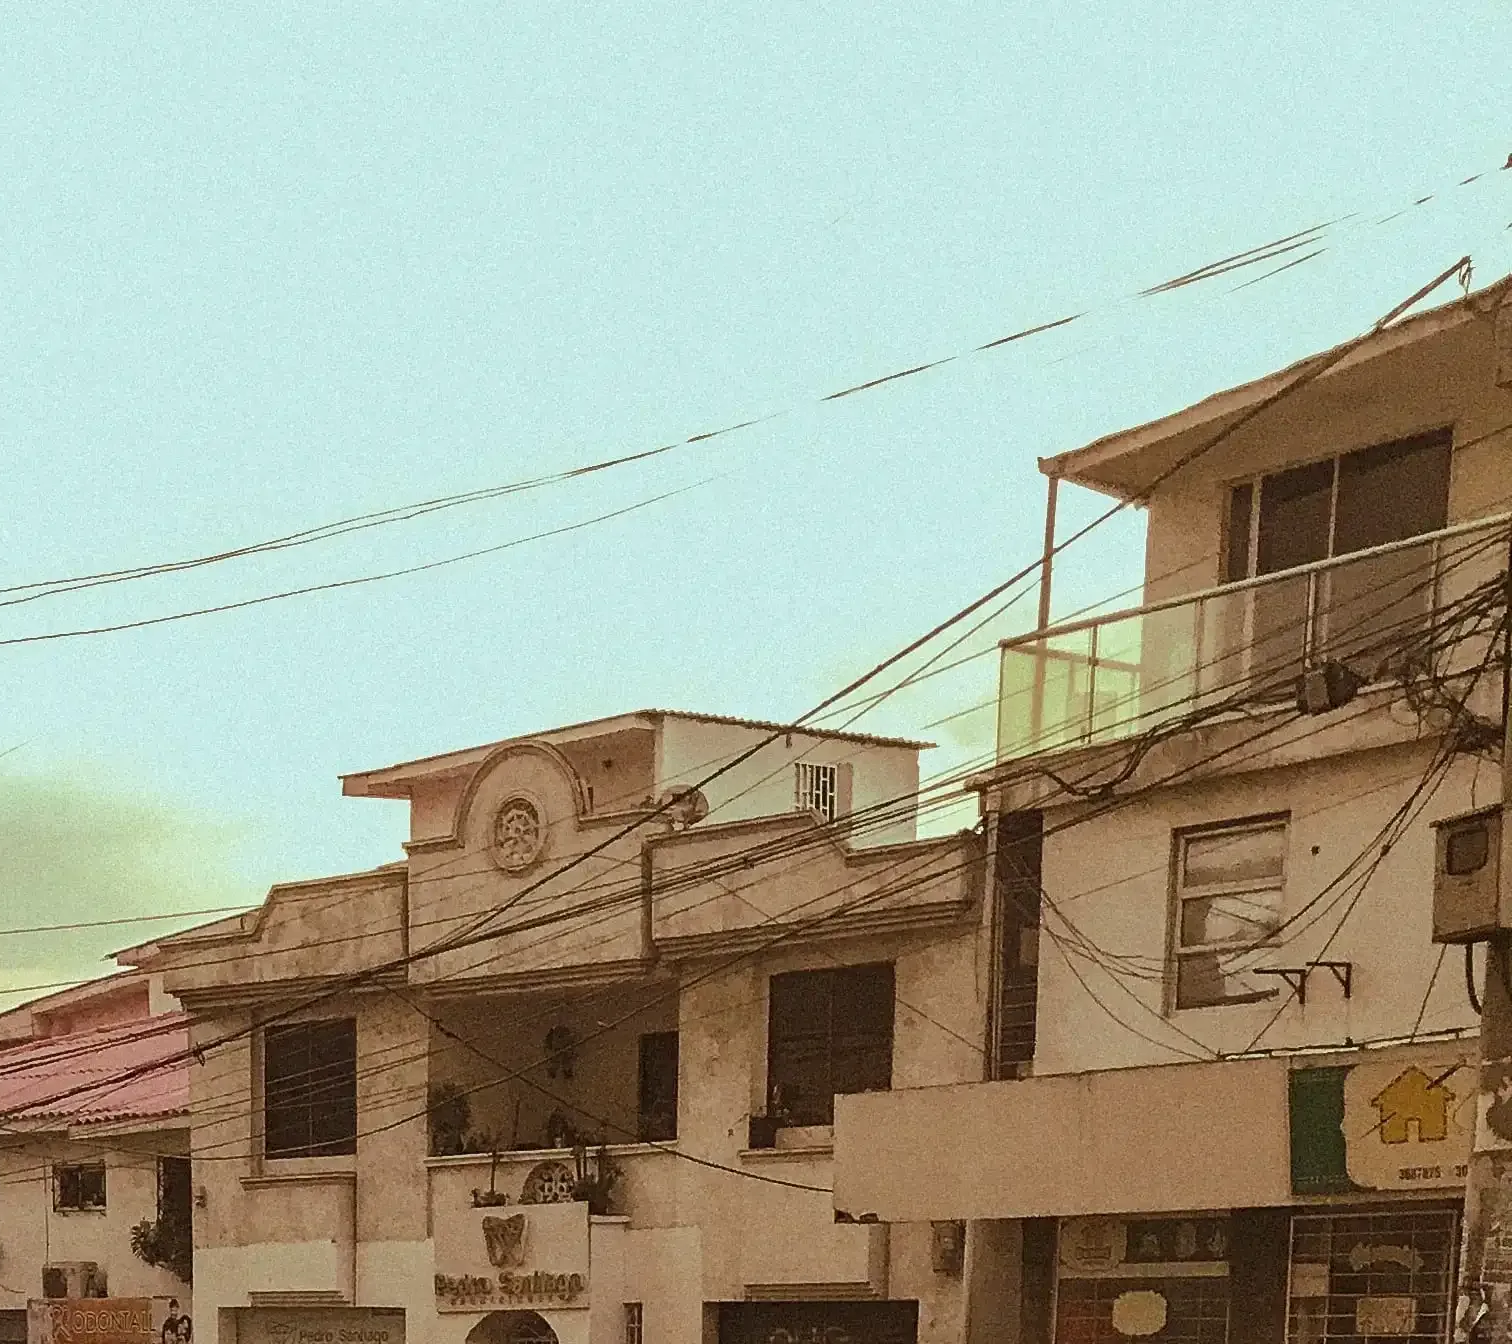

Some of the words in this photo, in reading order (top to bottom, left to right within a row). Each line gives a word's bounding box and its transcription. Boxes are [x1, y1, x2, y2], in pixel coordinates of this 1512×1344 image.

[435, 1273, 492, 1296] Pedro
[499, 1270, 585, 1303] Santiago
[299, 1328, 333, 1342] Pedro
